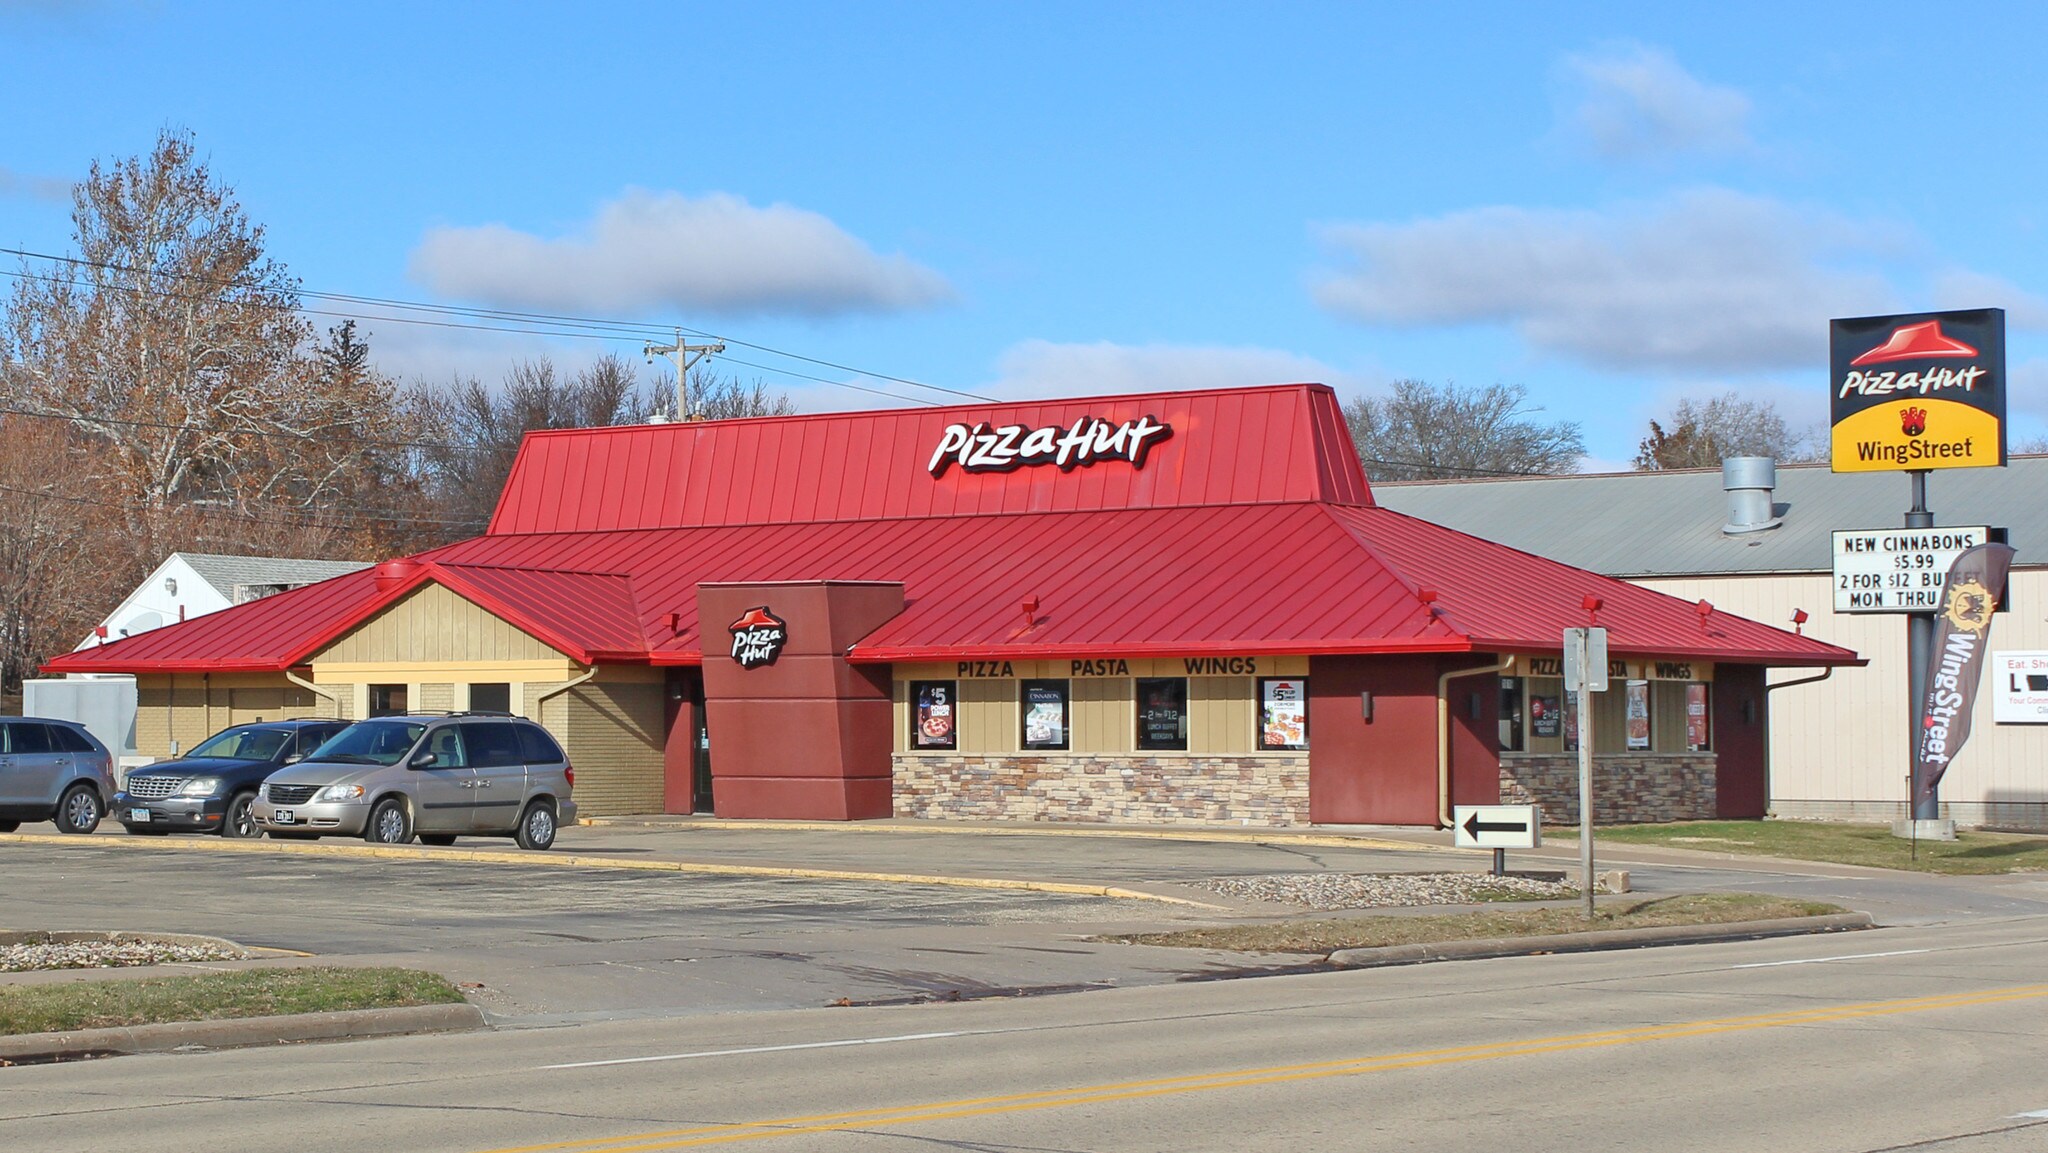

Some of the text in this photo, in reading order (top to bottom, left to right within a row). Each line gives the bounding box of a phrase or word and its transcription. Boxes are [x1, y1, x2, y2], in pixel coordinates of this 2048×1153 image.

[1857, 437, 1973, 464] WingStreet
[1845, 534, 1973, 552] NEW CINNABONS
[1894, 554, 1934, 569] $5.99
[1840, 575, 1848, 589] 2
[1853, 574, 1881, 588] FOR
[1888, 573, 1910, 587] $12
[1850, 591, 1936, 607] MON THRU
[731, 624, 781, 657] Pizza
[740, 642, 776, 665] Hut
[957, 660, 1014, 677] PIZZA
[1071, 658, 1129, 676] PASTA
[1184, 656, 1256, 675] WINGS
[1530, 658, 1564, 675] PIZZA
[1609, 660, 1628, 677] STA
[1655, 662, 1692, 679] WINGS
[931, 687, 946, 706] $5
[1925, 633, 1977, 764] WingStreet
